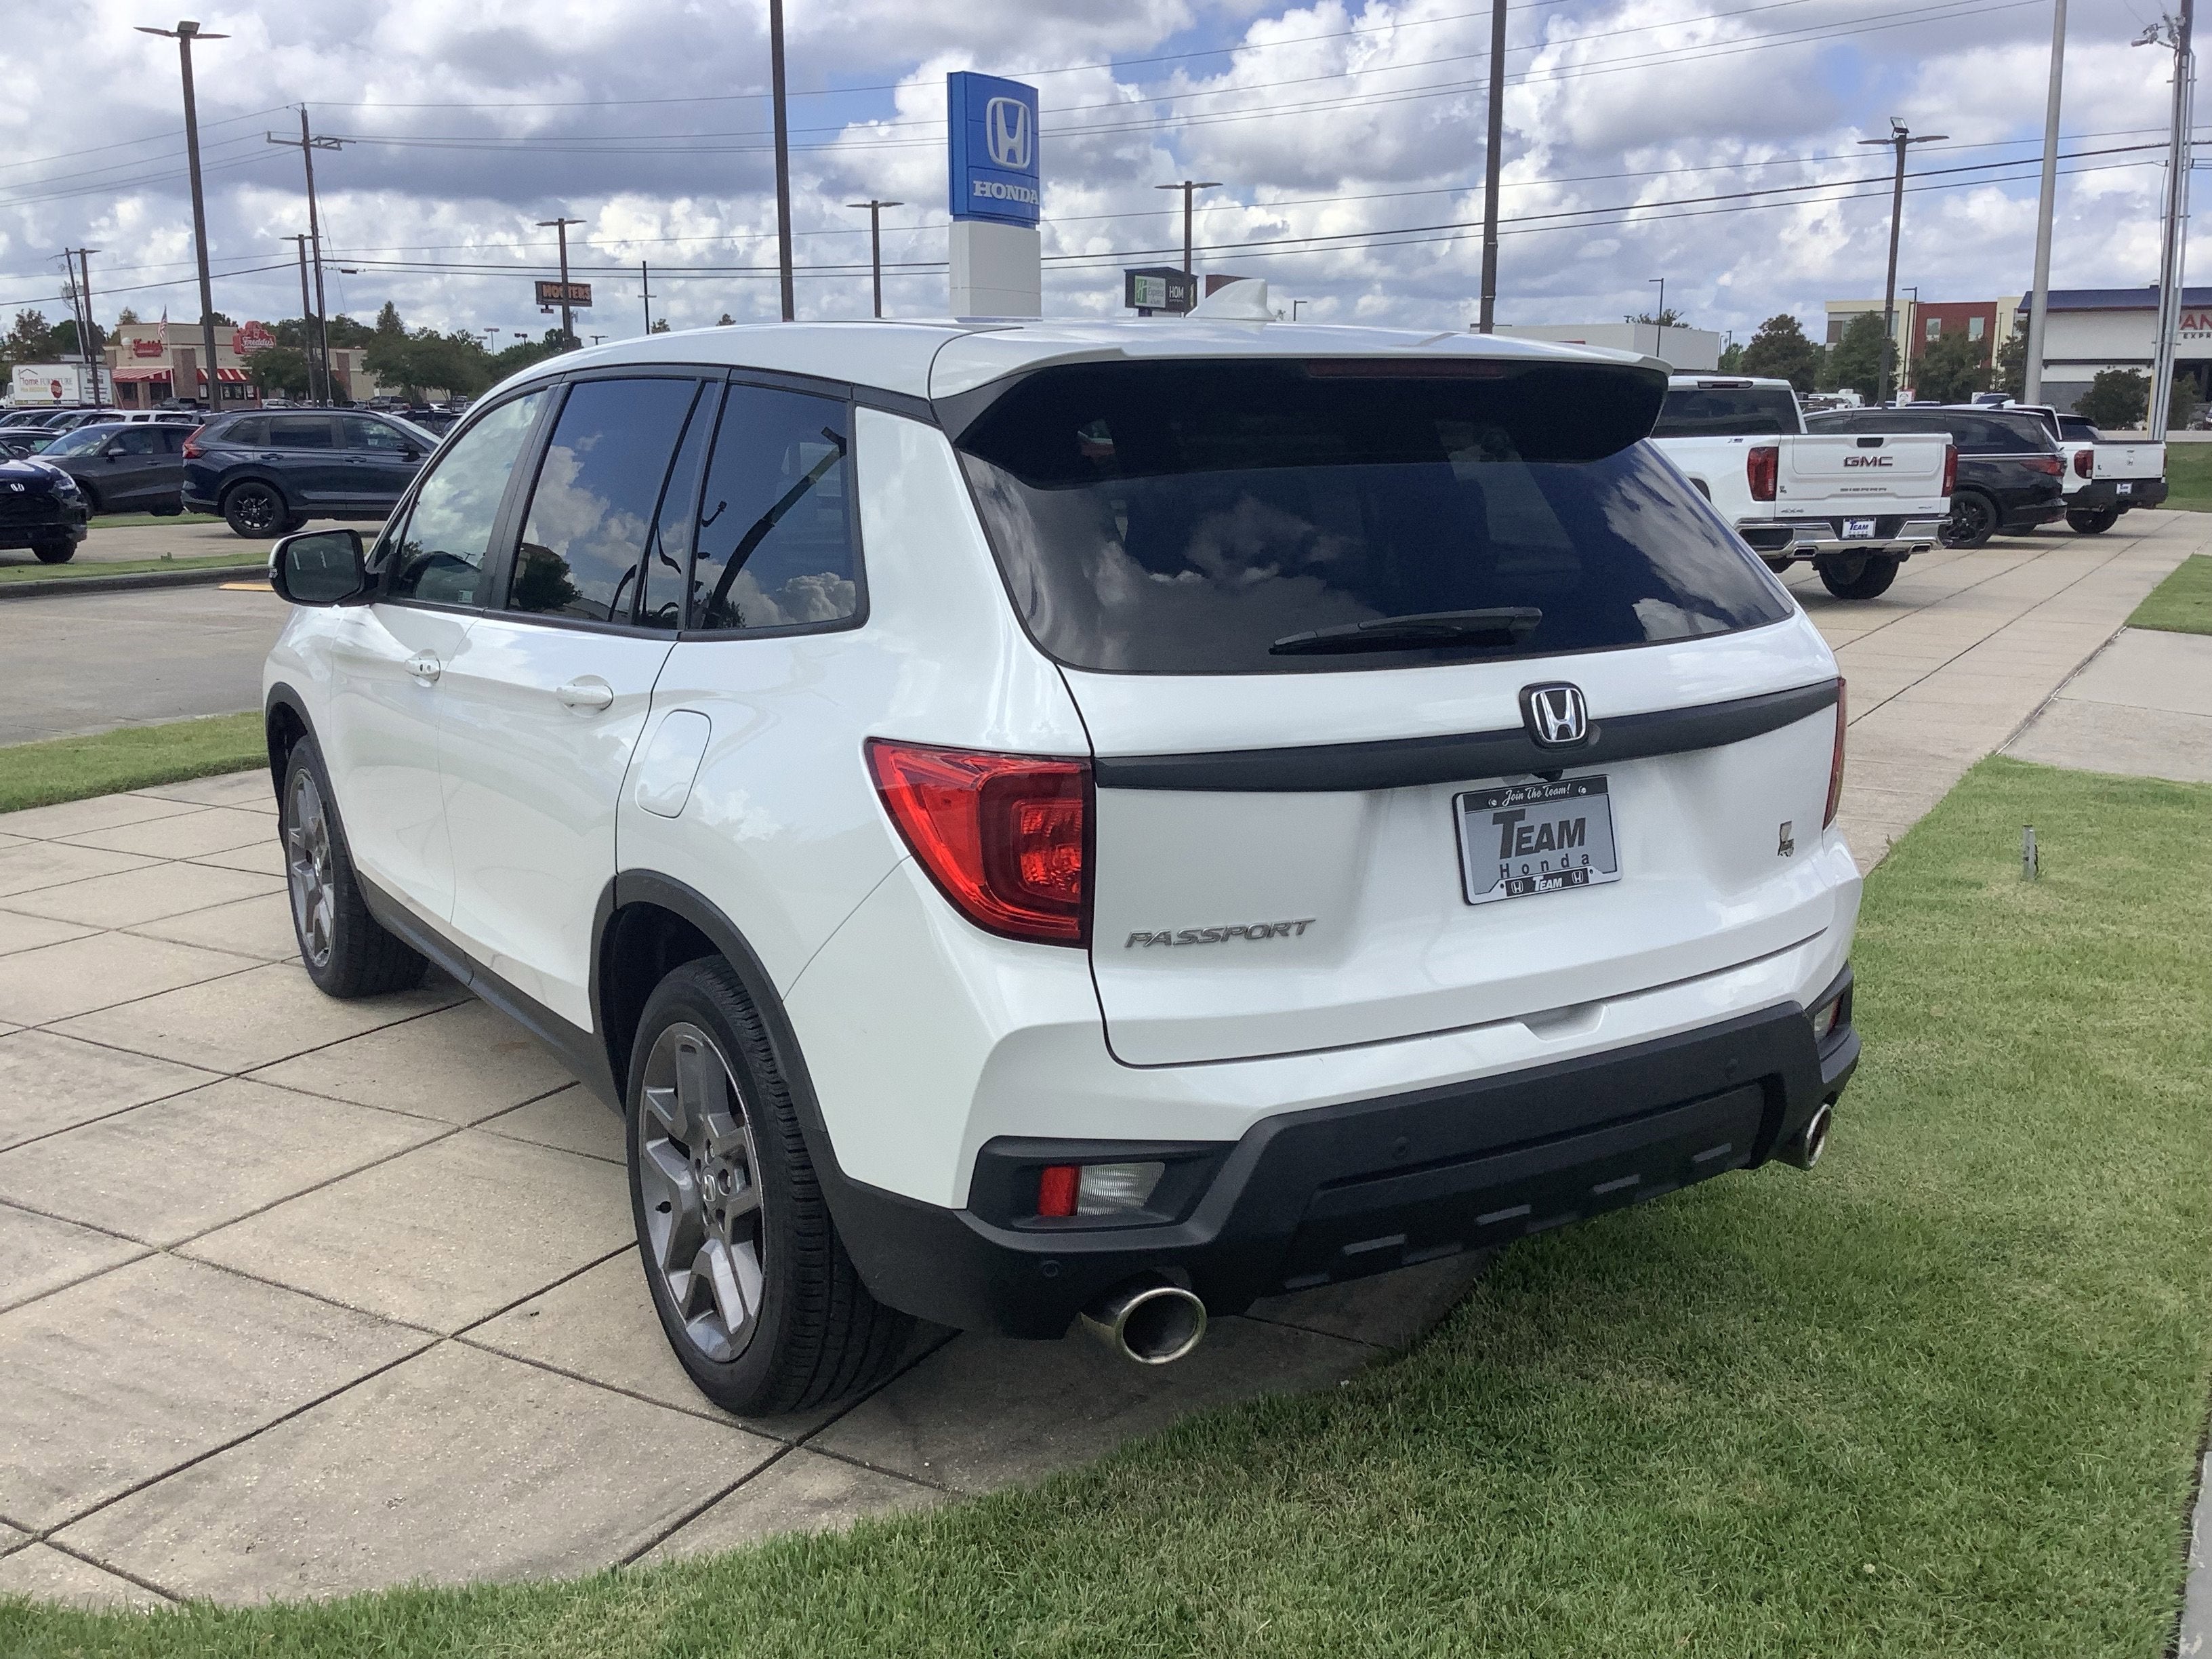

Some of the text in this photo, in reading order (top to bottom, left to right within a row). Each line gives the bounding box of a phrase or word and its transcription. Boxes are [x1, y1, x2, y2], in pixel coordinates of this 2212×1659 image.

[972, 180, 1040, 205] HONDA
[1169, 285, 1184, 299] HOM
[2179, 314, 2212, 330] AN
[39, 377, 73, 386] FURTURE
[1843, 455, 1893, 467] GMC
[1502, 783, 1572, 806] Join The Team!
[1492, 808, 1586, 860] TEAM
[1500, 853, 1590, 878] Honda
[1533, 876, 1563, 892] TEAM
[1124, 919, 1317, 948] PASSPORT
